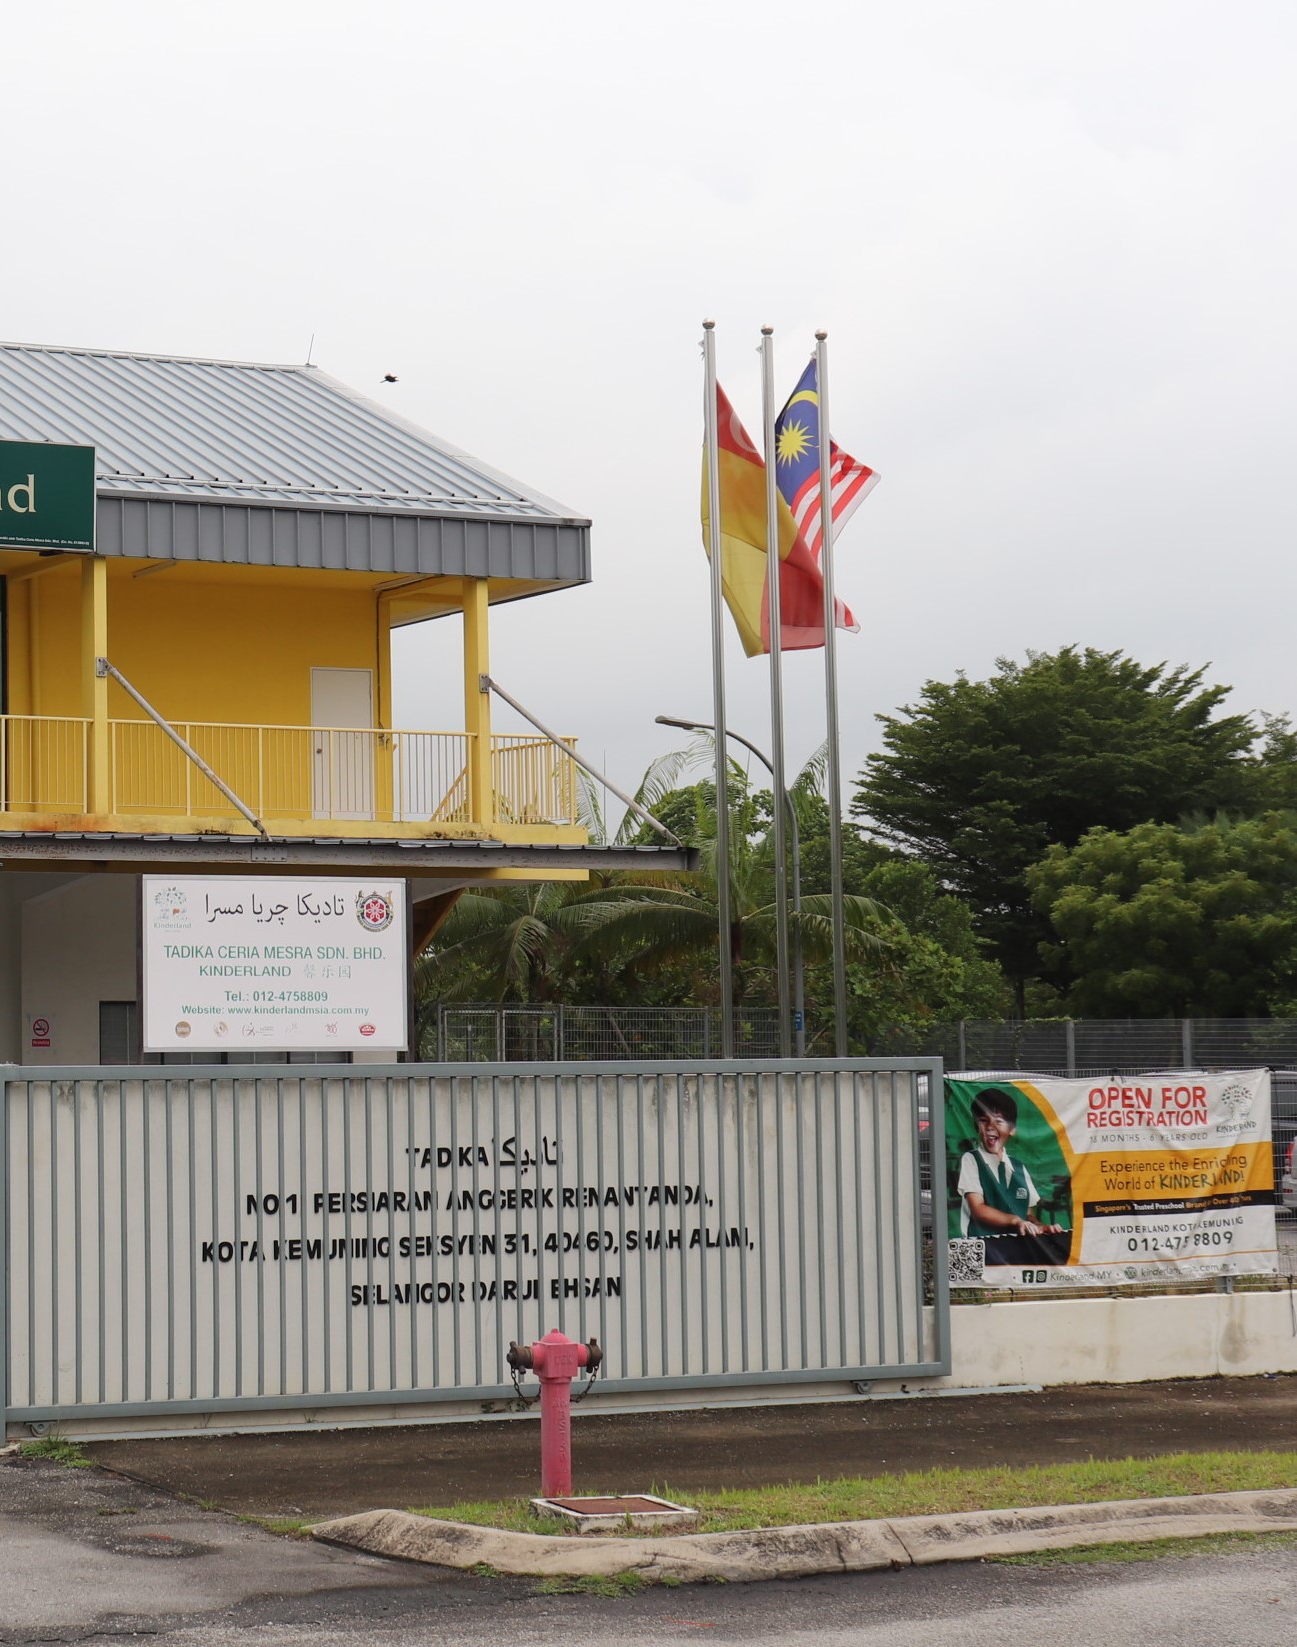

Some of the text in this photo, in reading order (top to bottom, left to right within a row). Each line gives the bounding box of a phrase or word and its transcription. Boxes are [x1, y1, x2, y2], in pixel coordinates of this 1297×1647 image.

[164, 946, 386, 960] TADIKA CERIA MESRA SDN. BHD.
[199, 966, 291, 977] KINDERLAND
[253, 990, 328, 1002] 012-4758809
[181, 1005, 370, 1016] Website: www.kinderlandmsia.com.my
[1088, 1086, 1207, 1110] OPEN FOR
[1087, 1110, 1208, 1128] REGISTRATION
[1101, 1134, 1140, 1142] MONTHS
[1189, 1132, 1208, 1140] OLD
[405, 1146, 489, 1168] ADKA
[1100, 1160, 1165, 1176] Experience
[1169, 1158, 1189, 1170] the
[1104, 1178, 1141, 1190] World
[1144, 1176, 1155, 1190] of
[1155, 1201, 1185, 1210] Preschool
[1110, 1224, 1170, 1234] KINDERLAND
[202, 1240, 265, 1262] KOTA
[505, 1233, 537, 1256] 31,
[626, 1229, 681, 1250] SHAH
